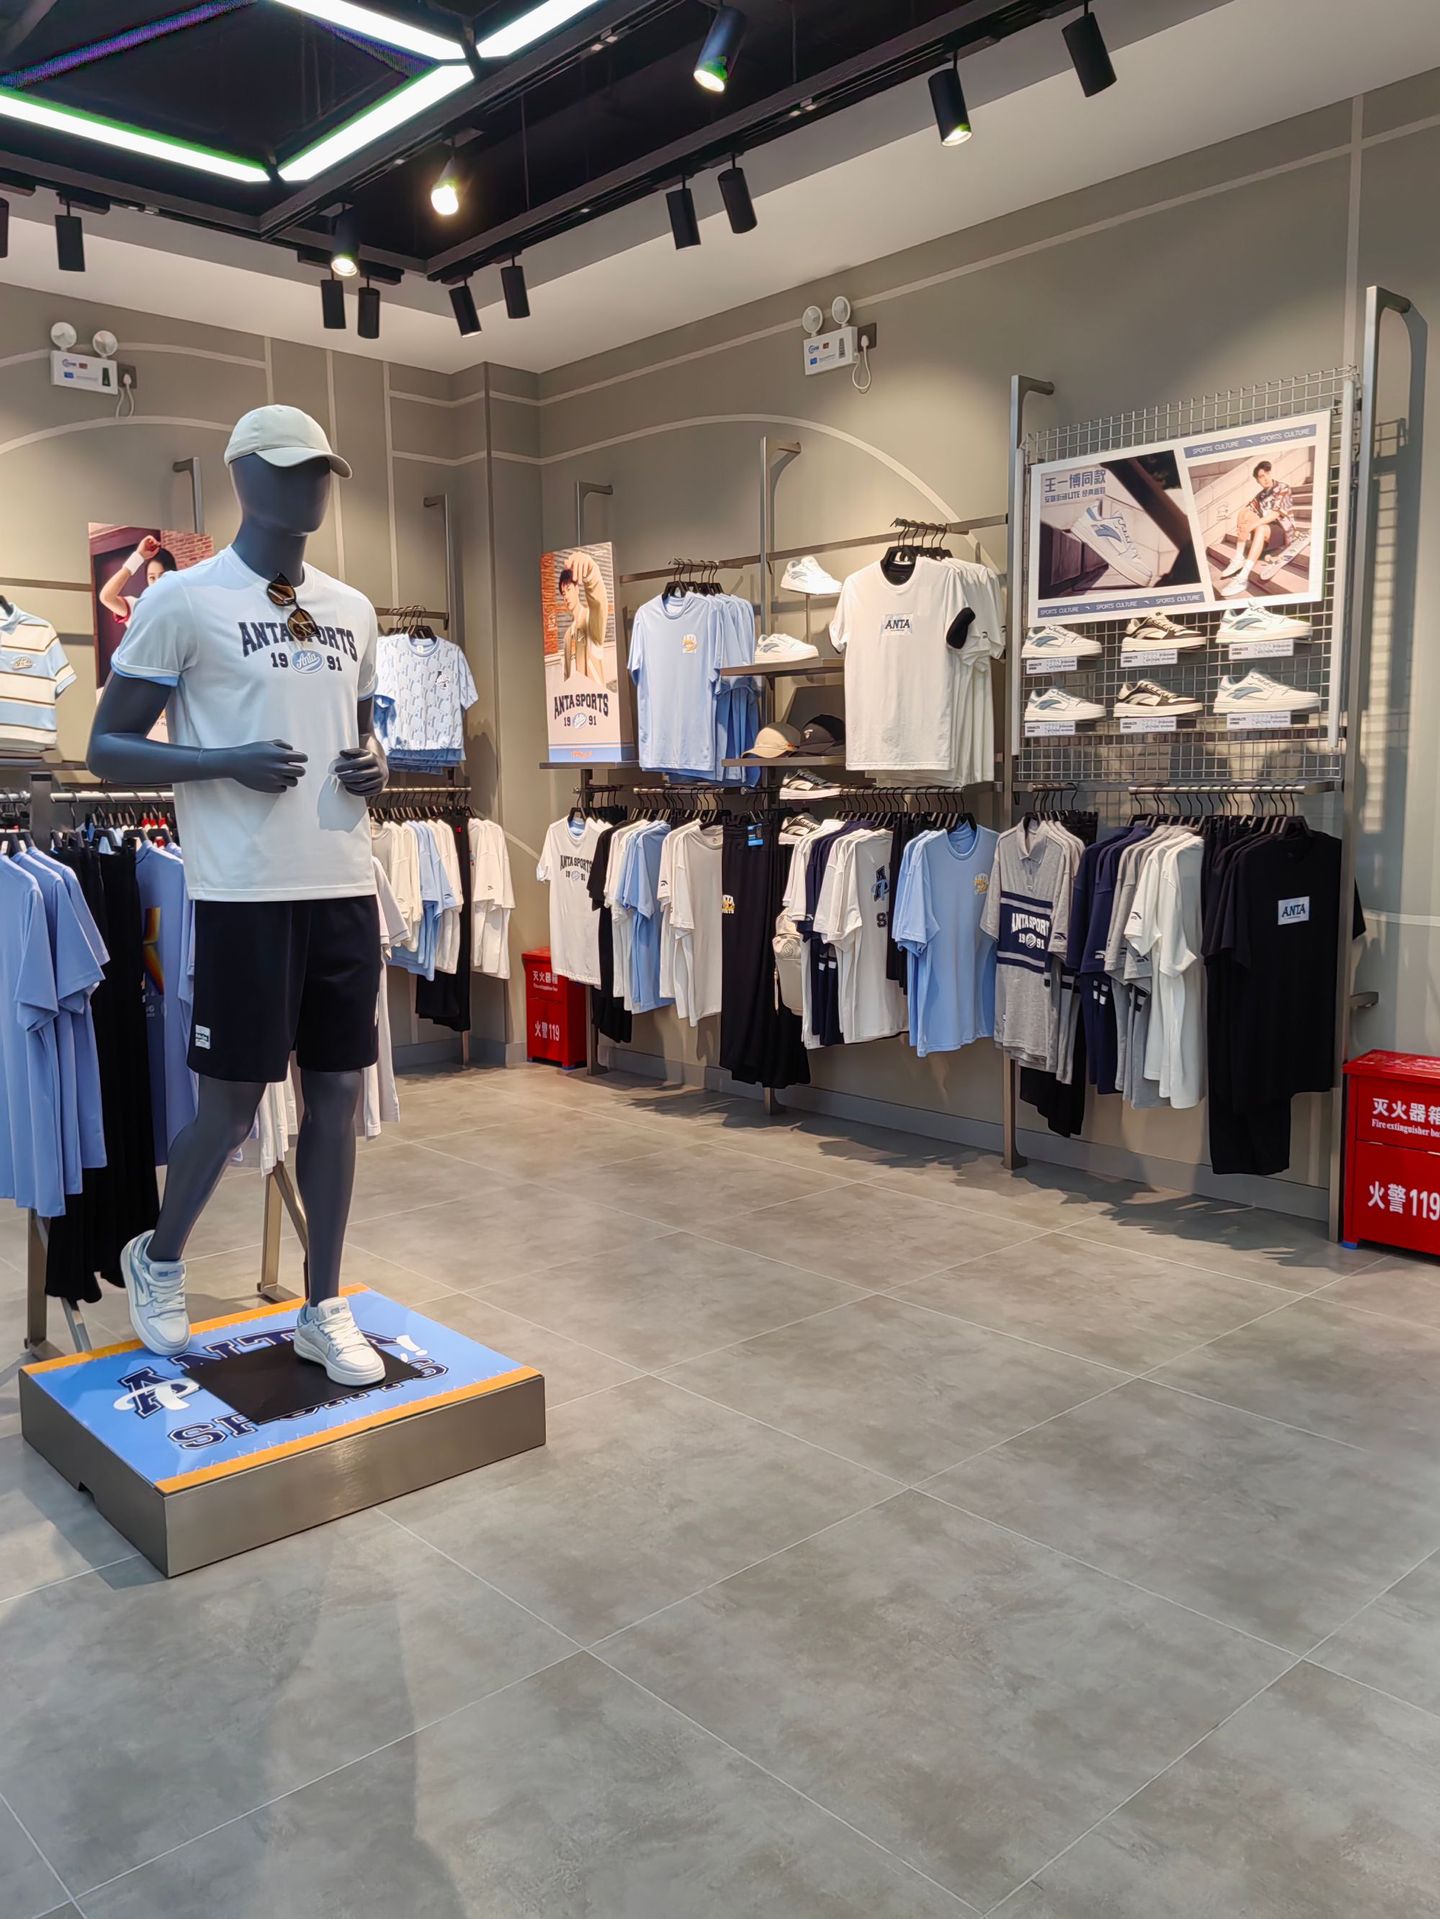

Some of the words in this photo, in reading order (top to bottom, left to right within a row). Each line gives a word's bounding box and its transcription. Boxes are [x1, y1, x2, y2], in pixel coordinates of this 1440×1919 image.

[1044, 469, 1106, 493] 王一博同款
[884, 619, 911, 630] ANTA
[238, 621, 294, 658] ANTA
[271, 652, 288, 668] 19
[327, 655, 343, 672] 91
[554, 694, 575, 720] ANTA
[575, 692, 609, 717] SPORTS
[563, 716, 571, 727] 19
[588, 715, 597, 726] 91
[1281, 903, 1306, 918] ANTA
[1036, 938, 1045, 950] 91
[1372, 1097, 1440, 1126] 灭火器箱
[1371, 1118, 1387, 1129] Fire
[1386, 1122, 1430, 1136] extinguisher
